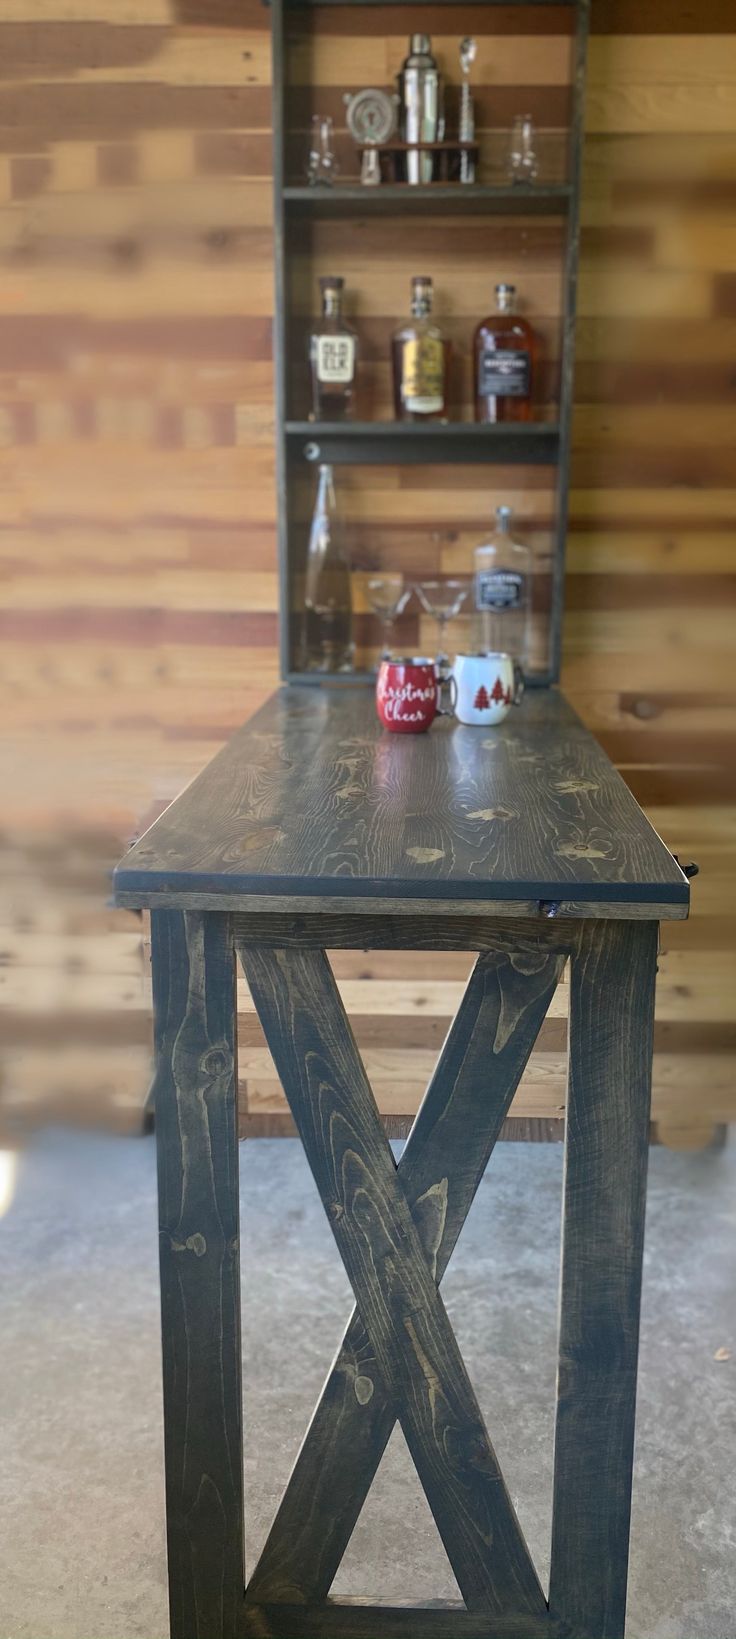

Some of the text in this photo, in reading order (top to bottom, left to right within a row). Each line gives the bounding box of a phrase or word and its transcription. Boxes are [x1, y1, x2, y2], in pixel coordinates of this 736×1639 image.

[323, 356, 348, 370] ELK
[377, 681, 435, 703] hristmas
[384, 699, 426, 721] Cheer
